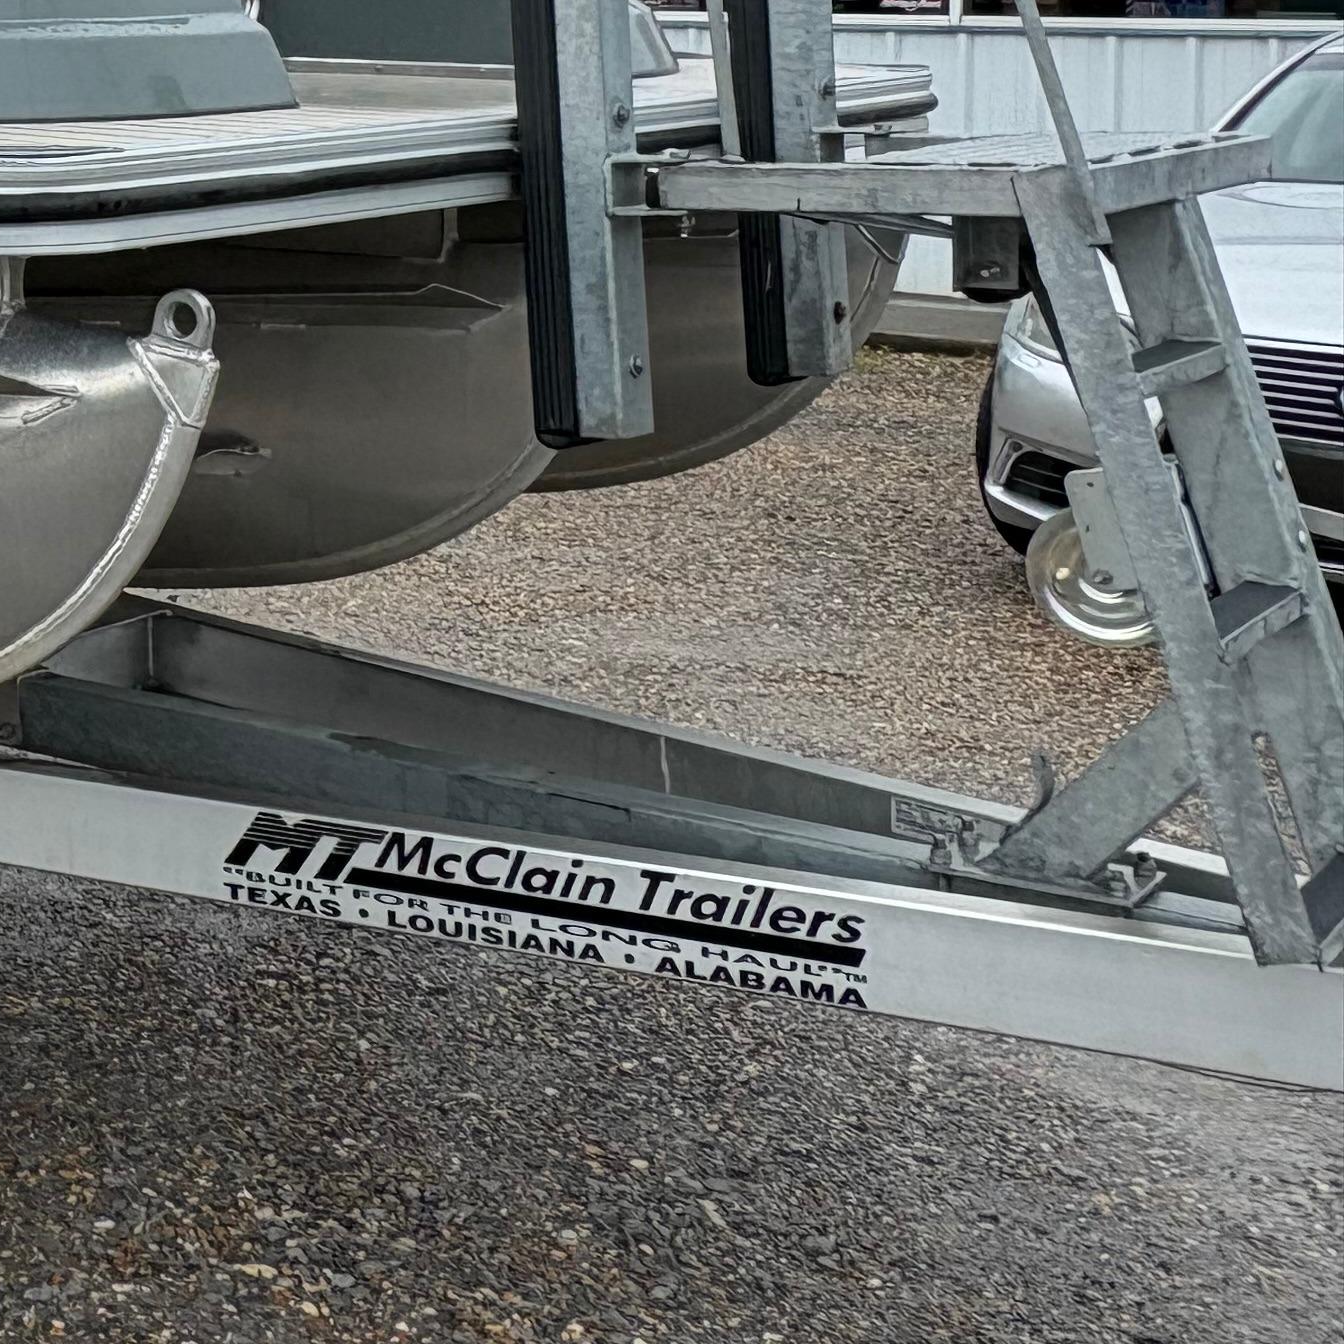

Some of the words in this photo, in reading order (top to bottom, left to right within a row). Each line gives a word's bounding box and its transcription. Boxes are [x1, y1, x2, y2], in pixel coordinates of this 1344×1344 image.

[374, 831, 616, 904] McClain
[638, 869, 866, 943] Trailers
[530, 918, 682, 954] LONG
[223, 882, 342, 918] TEXAS
[387, 910, 605, 963] LOUISIANA
[655, 956, 868, 1008] ALABAMA
